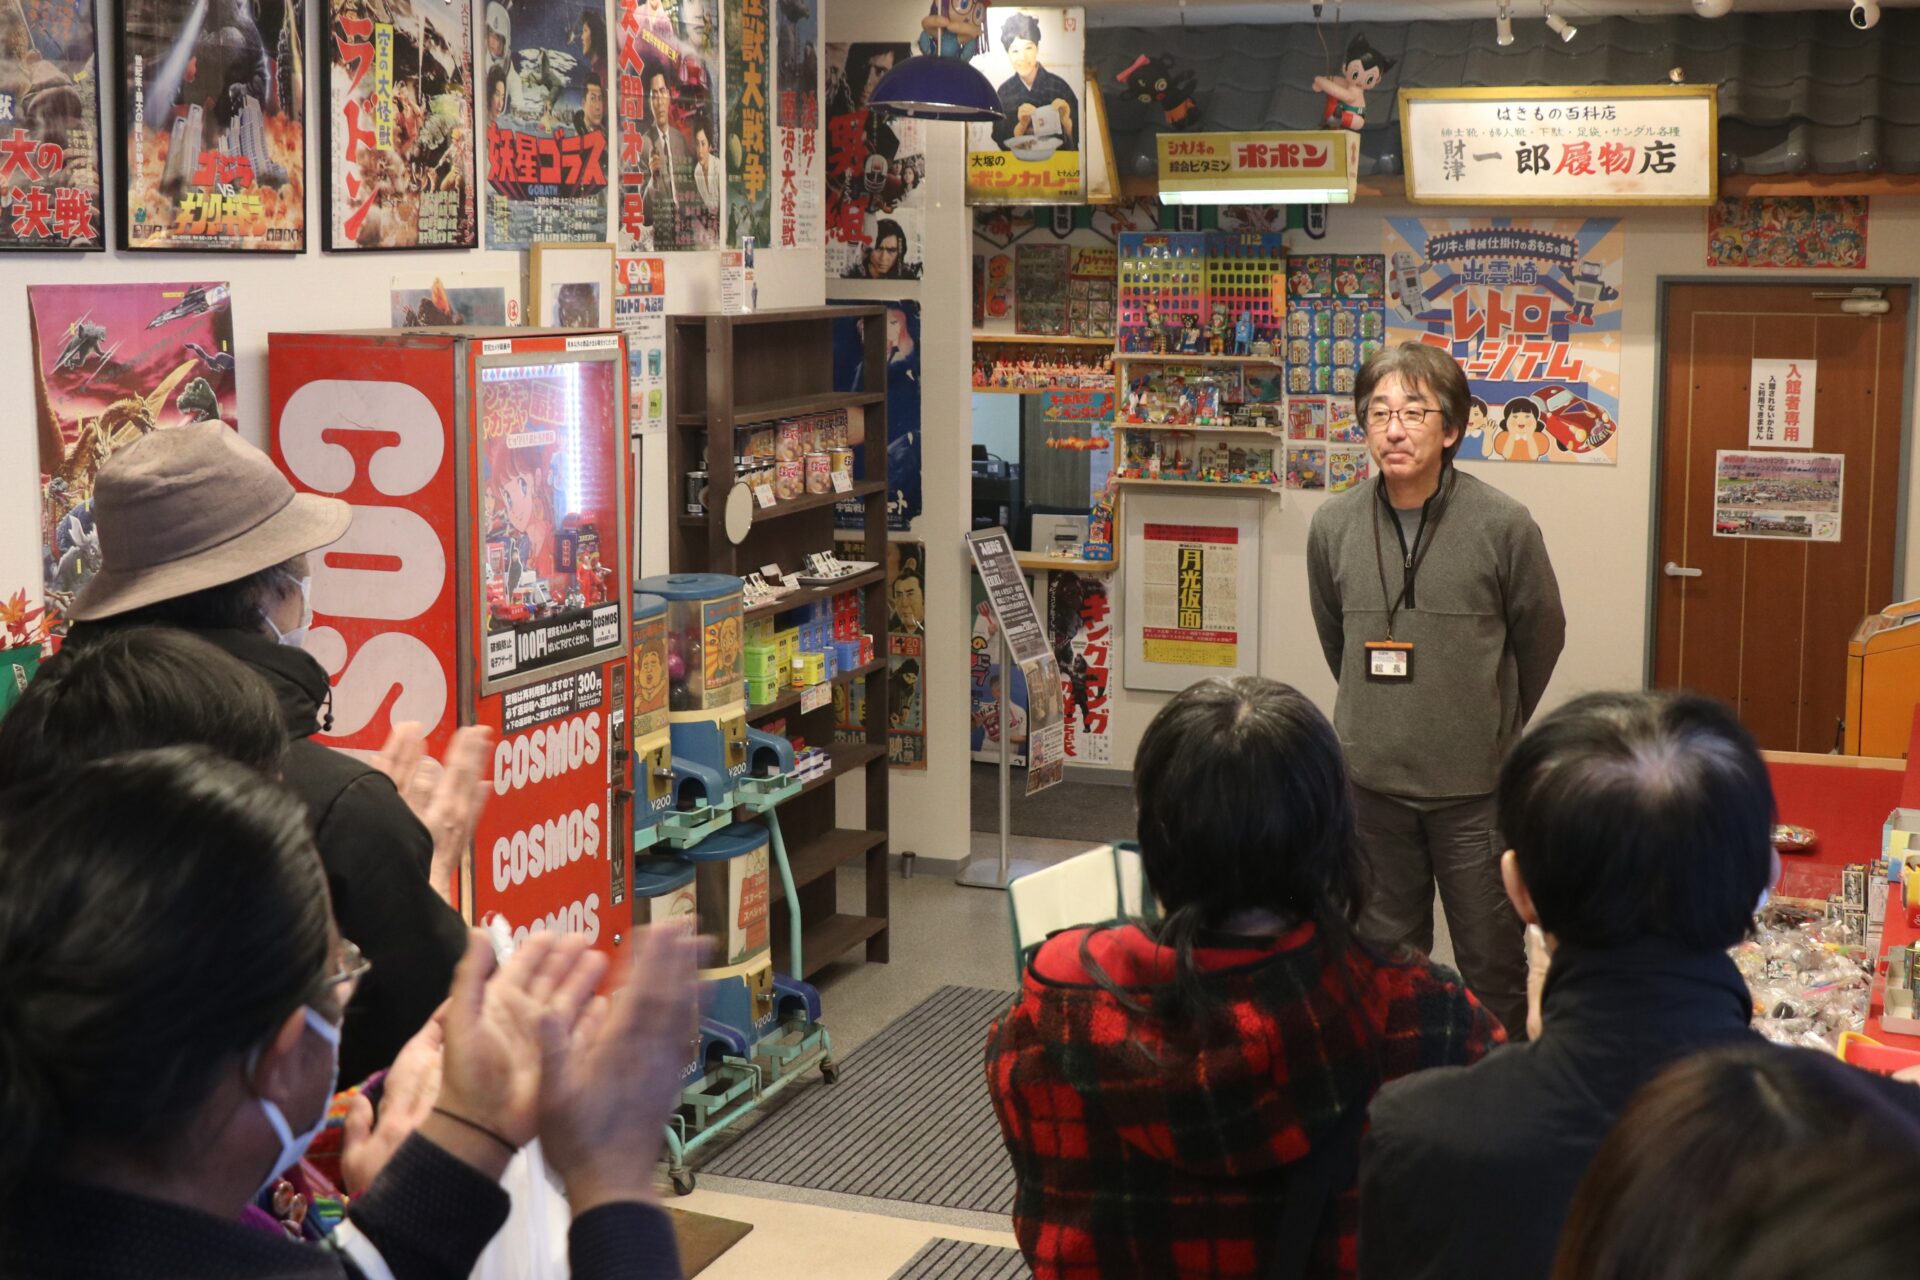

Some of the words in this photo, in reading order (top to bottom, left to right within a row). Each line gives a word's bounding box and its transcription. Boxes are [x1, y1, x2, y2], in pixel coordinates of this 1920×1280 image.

[375, 28, 392, 148] 空の大怪獣
[336, 16, 379, 242] ラドン
[1496, 105, 1617, 122] はきもの百科店
[487, 127, 608, 187] 妖星ゴラス
[971, 154, 1006, 168] 大塚の
[1167, 140, 1215, 156] シオノギの
[1168, 158, 1231, 174] 総合ビタミン
[1236, 143, 1328, 169] ポポン
[1442, 139, 1467, 182] 財津
[191, 150, 256, 189] ゴジラ
[971, 169, 1080, 188] ボンカレー
[217, 183, 236, 198] VS
[528, 184, 559, 196] GORATH
[11, 186, 97, 240] 決戦
[175, 191, 267, 236] キングギドラ
[1461, 259, 1539, 286] 出雲崎
[1451, 288, 1553, 342] レトロ
[1756, 382, 1766, 441] ご利用できません
[1783, 363, 1802, 442] 入館者専用
[1179, 549, 1202, 628] 月光仮面
[593, 611, 618, 629] COSMOS
[490, 639, 512, 653] 破損防止
[518, 627, 548, 663] 100円
[577, 670, 603, 695] 300円
[492, 711, 601, 797] COSMOS
[650, 794, 672, 811] ¥200
[492, 802, 600, 893] COSMOS
